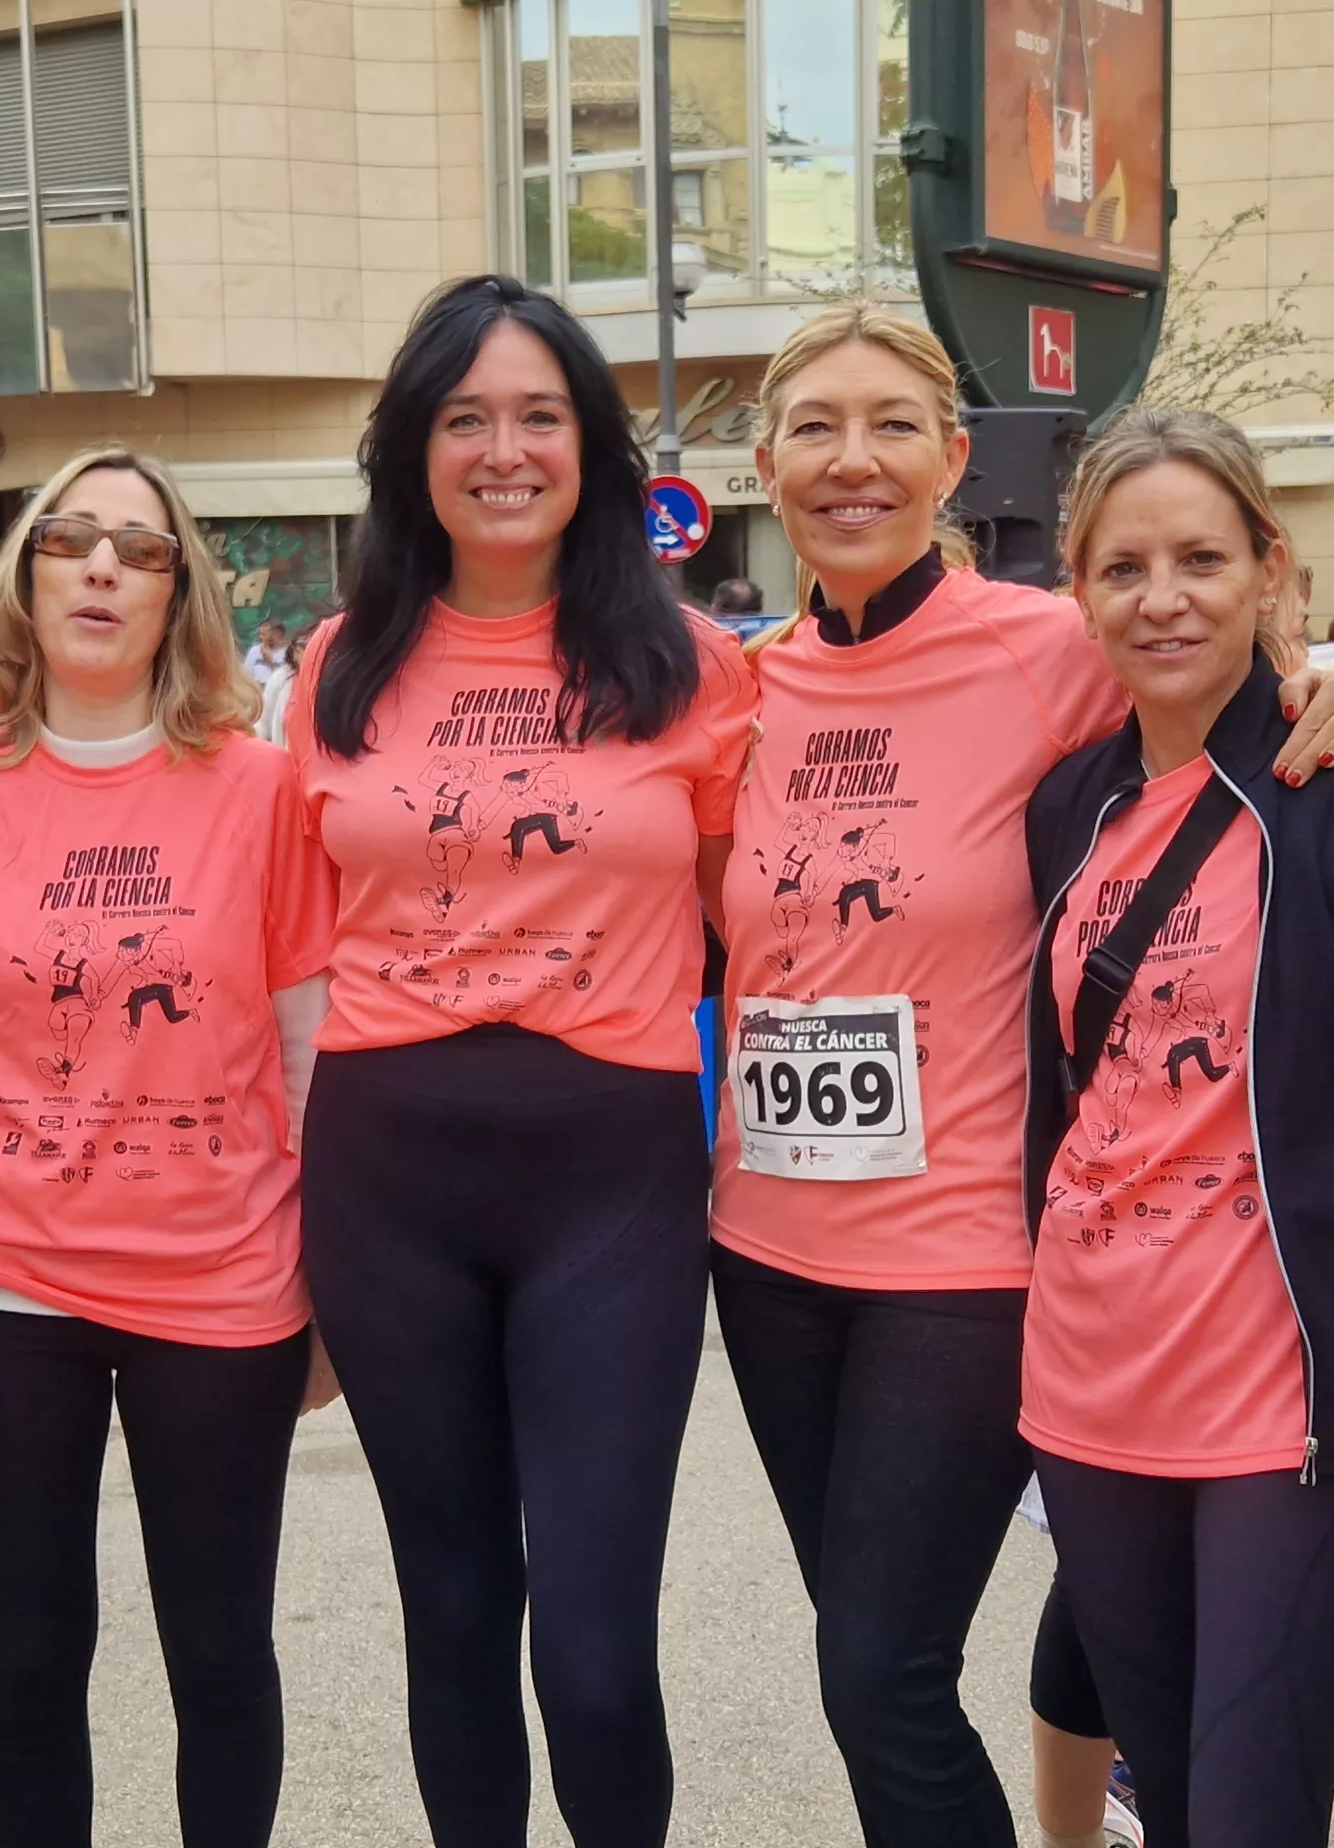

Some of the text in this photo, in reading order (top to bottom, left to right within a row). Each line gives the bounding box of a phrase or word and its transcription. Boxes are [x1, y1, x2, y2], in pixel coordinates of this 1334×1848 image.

[726, 476, 763, 494] GR
[451, 687, 550, 717] CORRAMOS
[426, 718, 464, 747] POR
[466, 716, 487, 746] LA
[805, 728, 892, 766] CORRAMOS
[786, 762, 900, 803] POR LA CIENCIA
[436, 799, 449, 813] 19
[63, 846, 160, 880] CORRAMOS
[782, 863, 794, 875] 19
[39, 876, 172, 911] POR LA CIENCIA
[1096, 877, 1198, 917] CORS
[1150, 905, 1202, 948] NCIA
[499, 948, 536, 957] URBAN
[54, 969, 69, 984] 19
[744, 1028, 888, 1050] CONTRA EL CÁNCER
[781, 1018, 827, 1033] HUESCA
[743, 1060, 894, 1127] 1969
[123, 1116, 160, 1125] URBAN
